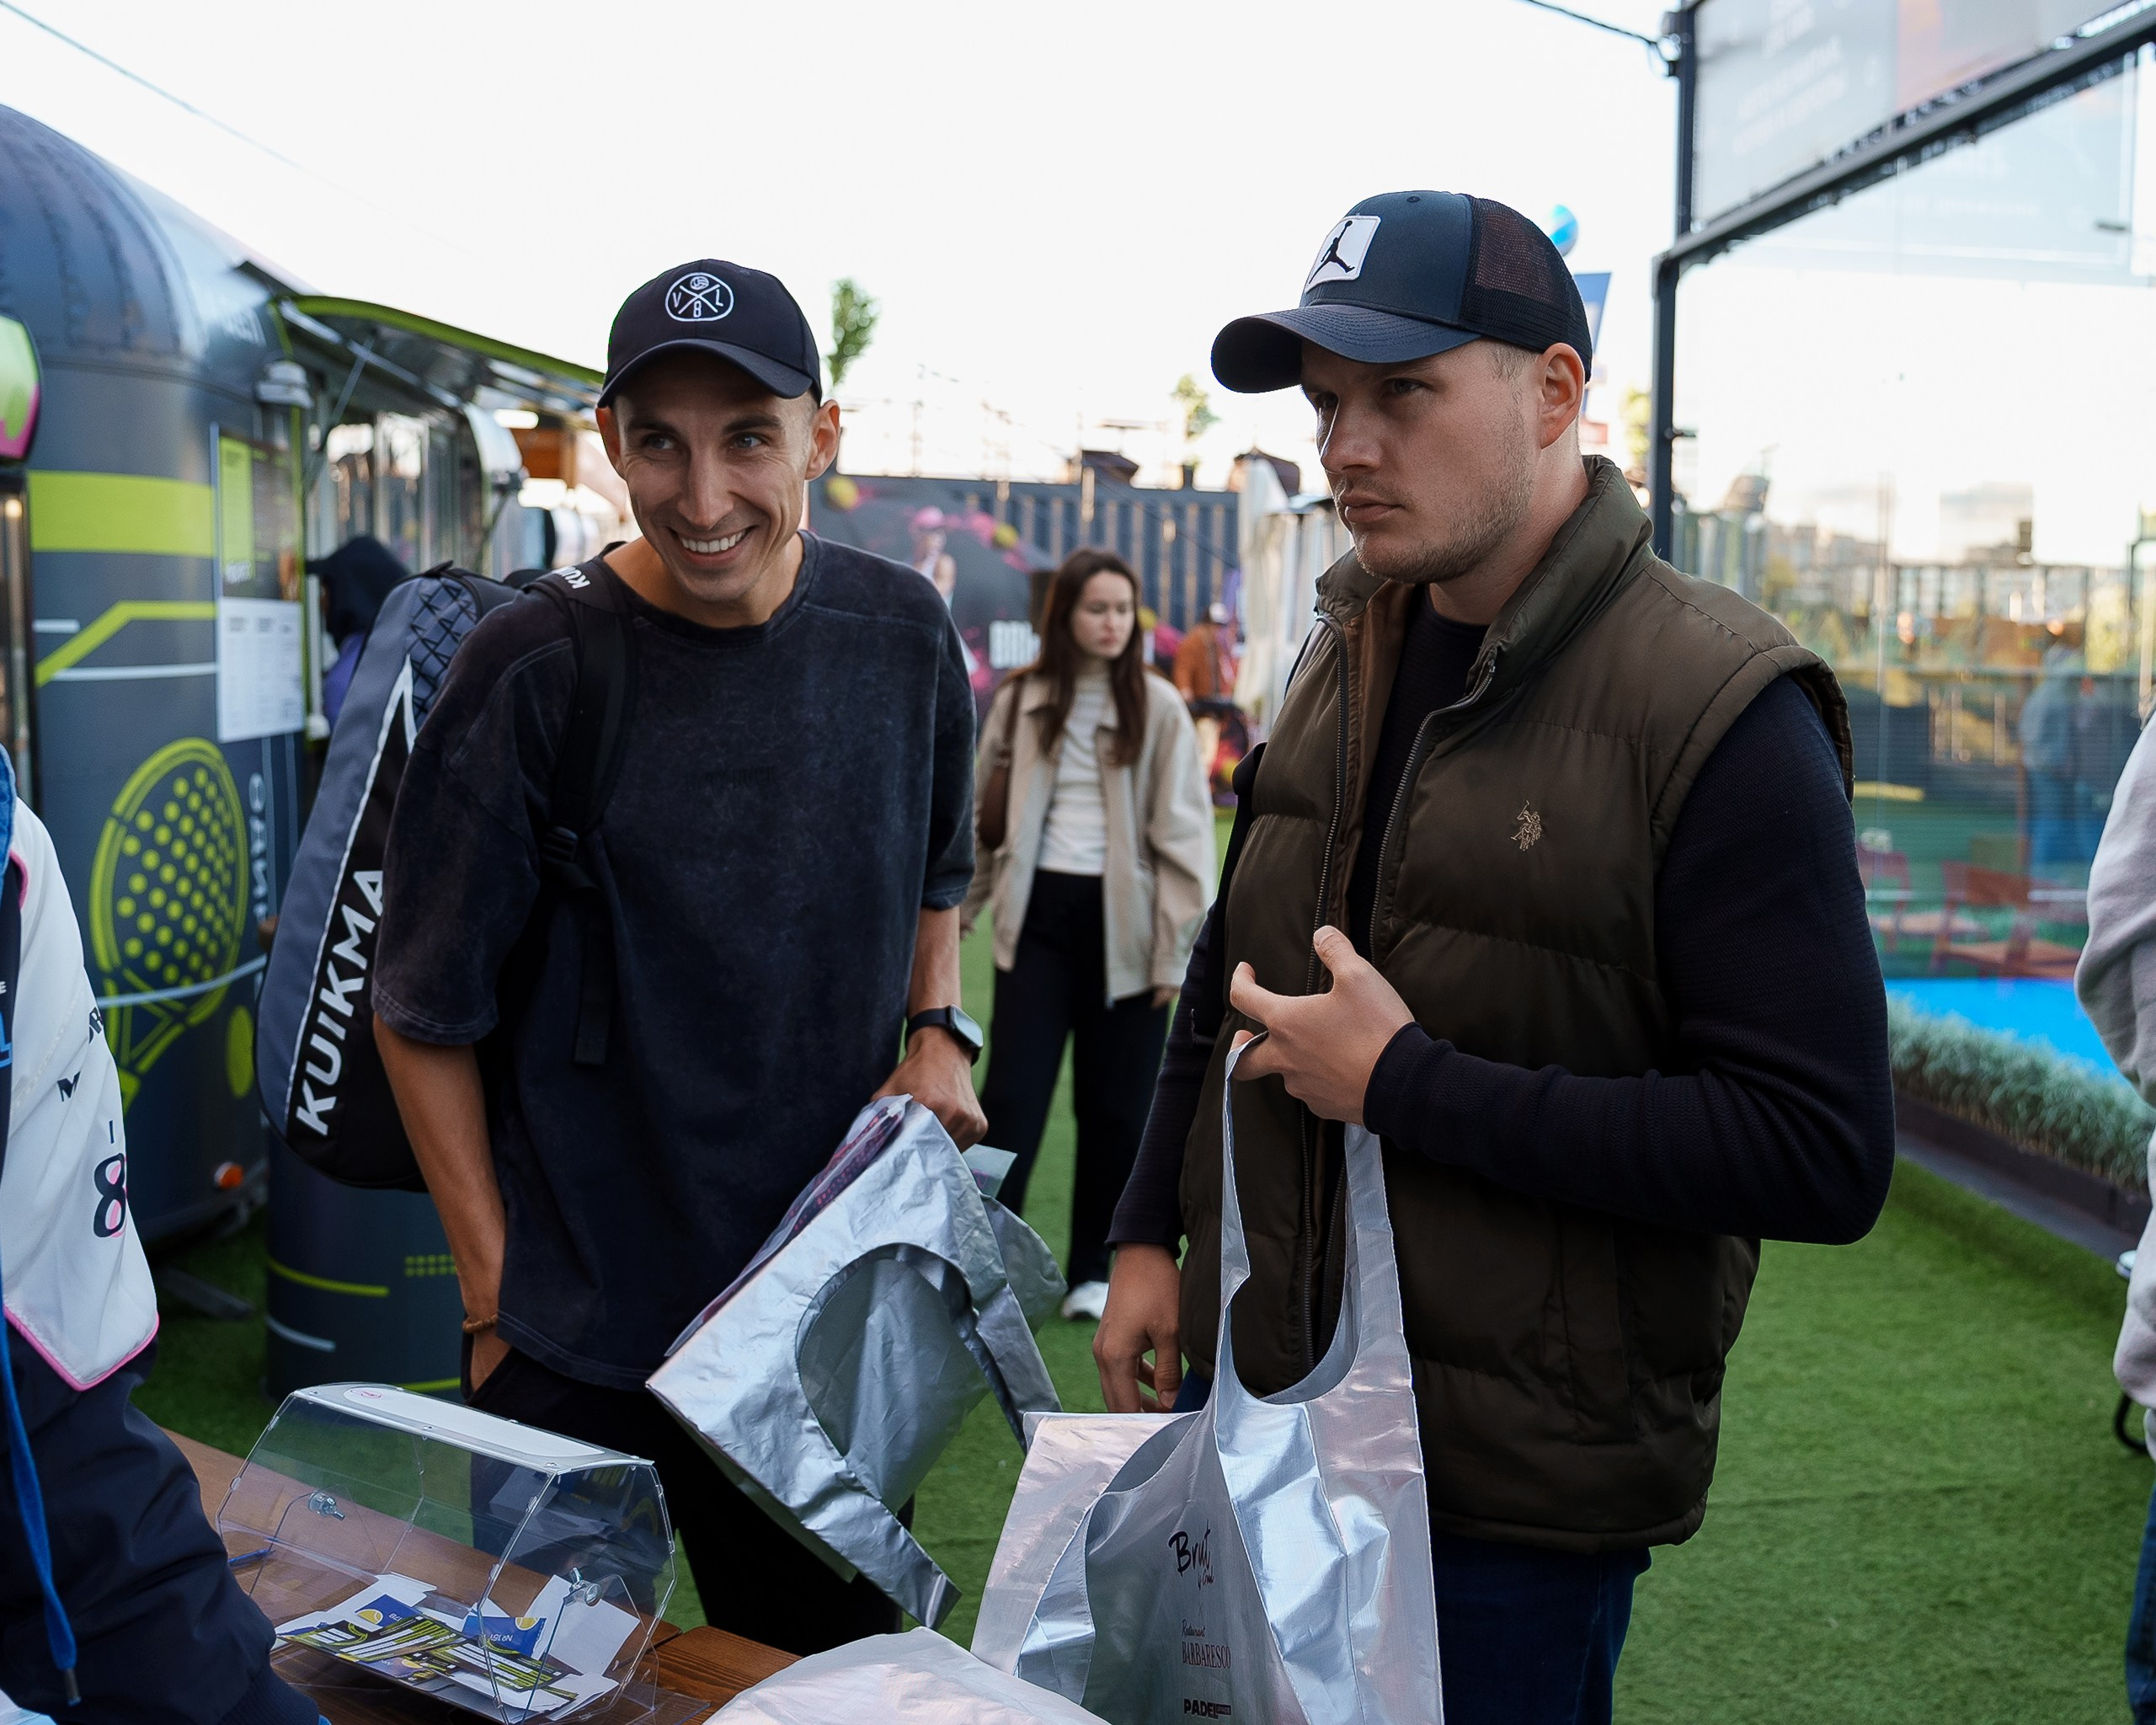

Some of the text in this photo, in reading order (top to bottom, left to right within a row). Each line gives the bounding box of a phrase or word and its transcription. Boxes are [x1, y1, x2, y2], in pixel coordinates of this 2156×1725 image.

[296, 871, 383, 1136] KUIKMA
[93, 1153, 125, 1237] 8
[1182, 1641, 1231, 1669] BARBARESCO
[1183, 1698, 1219, 1719] PADEL
